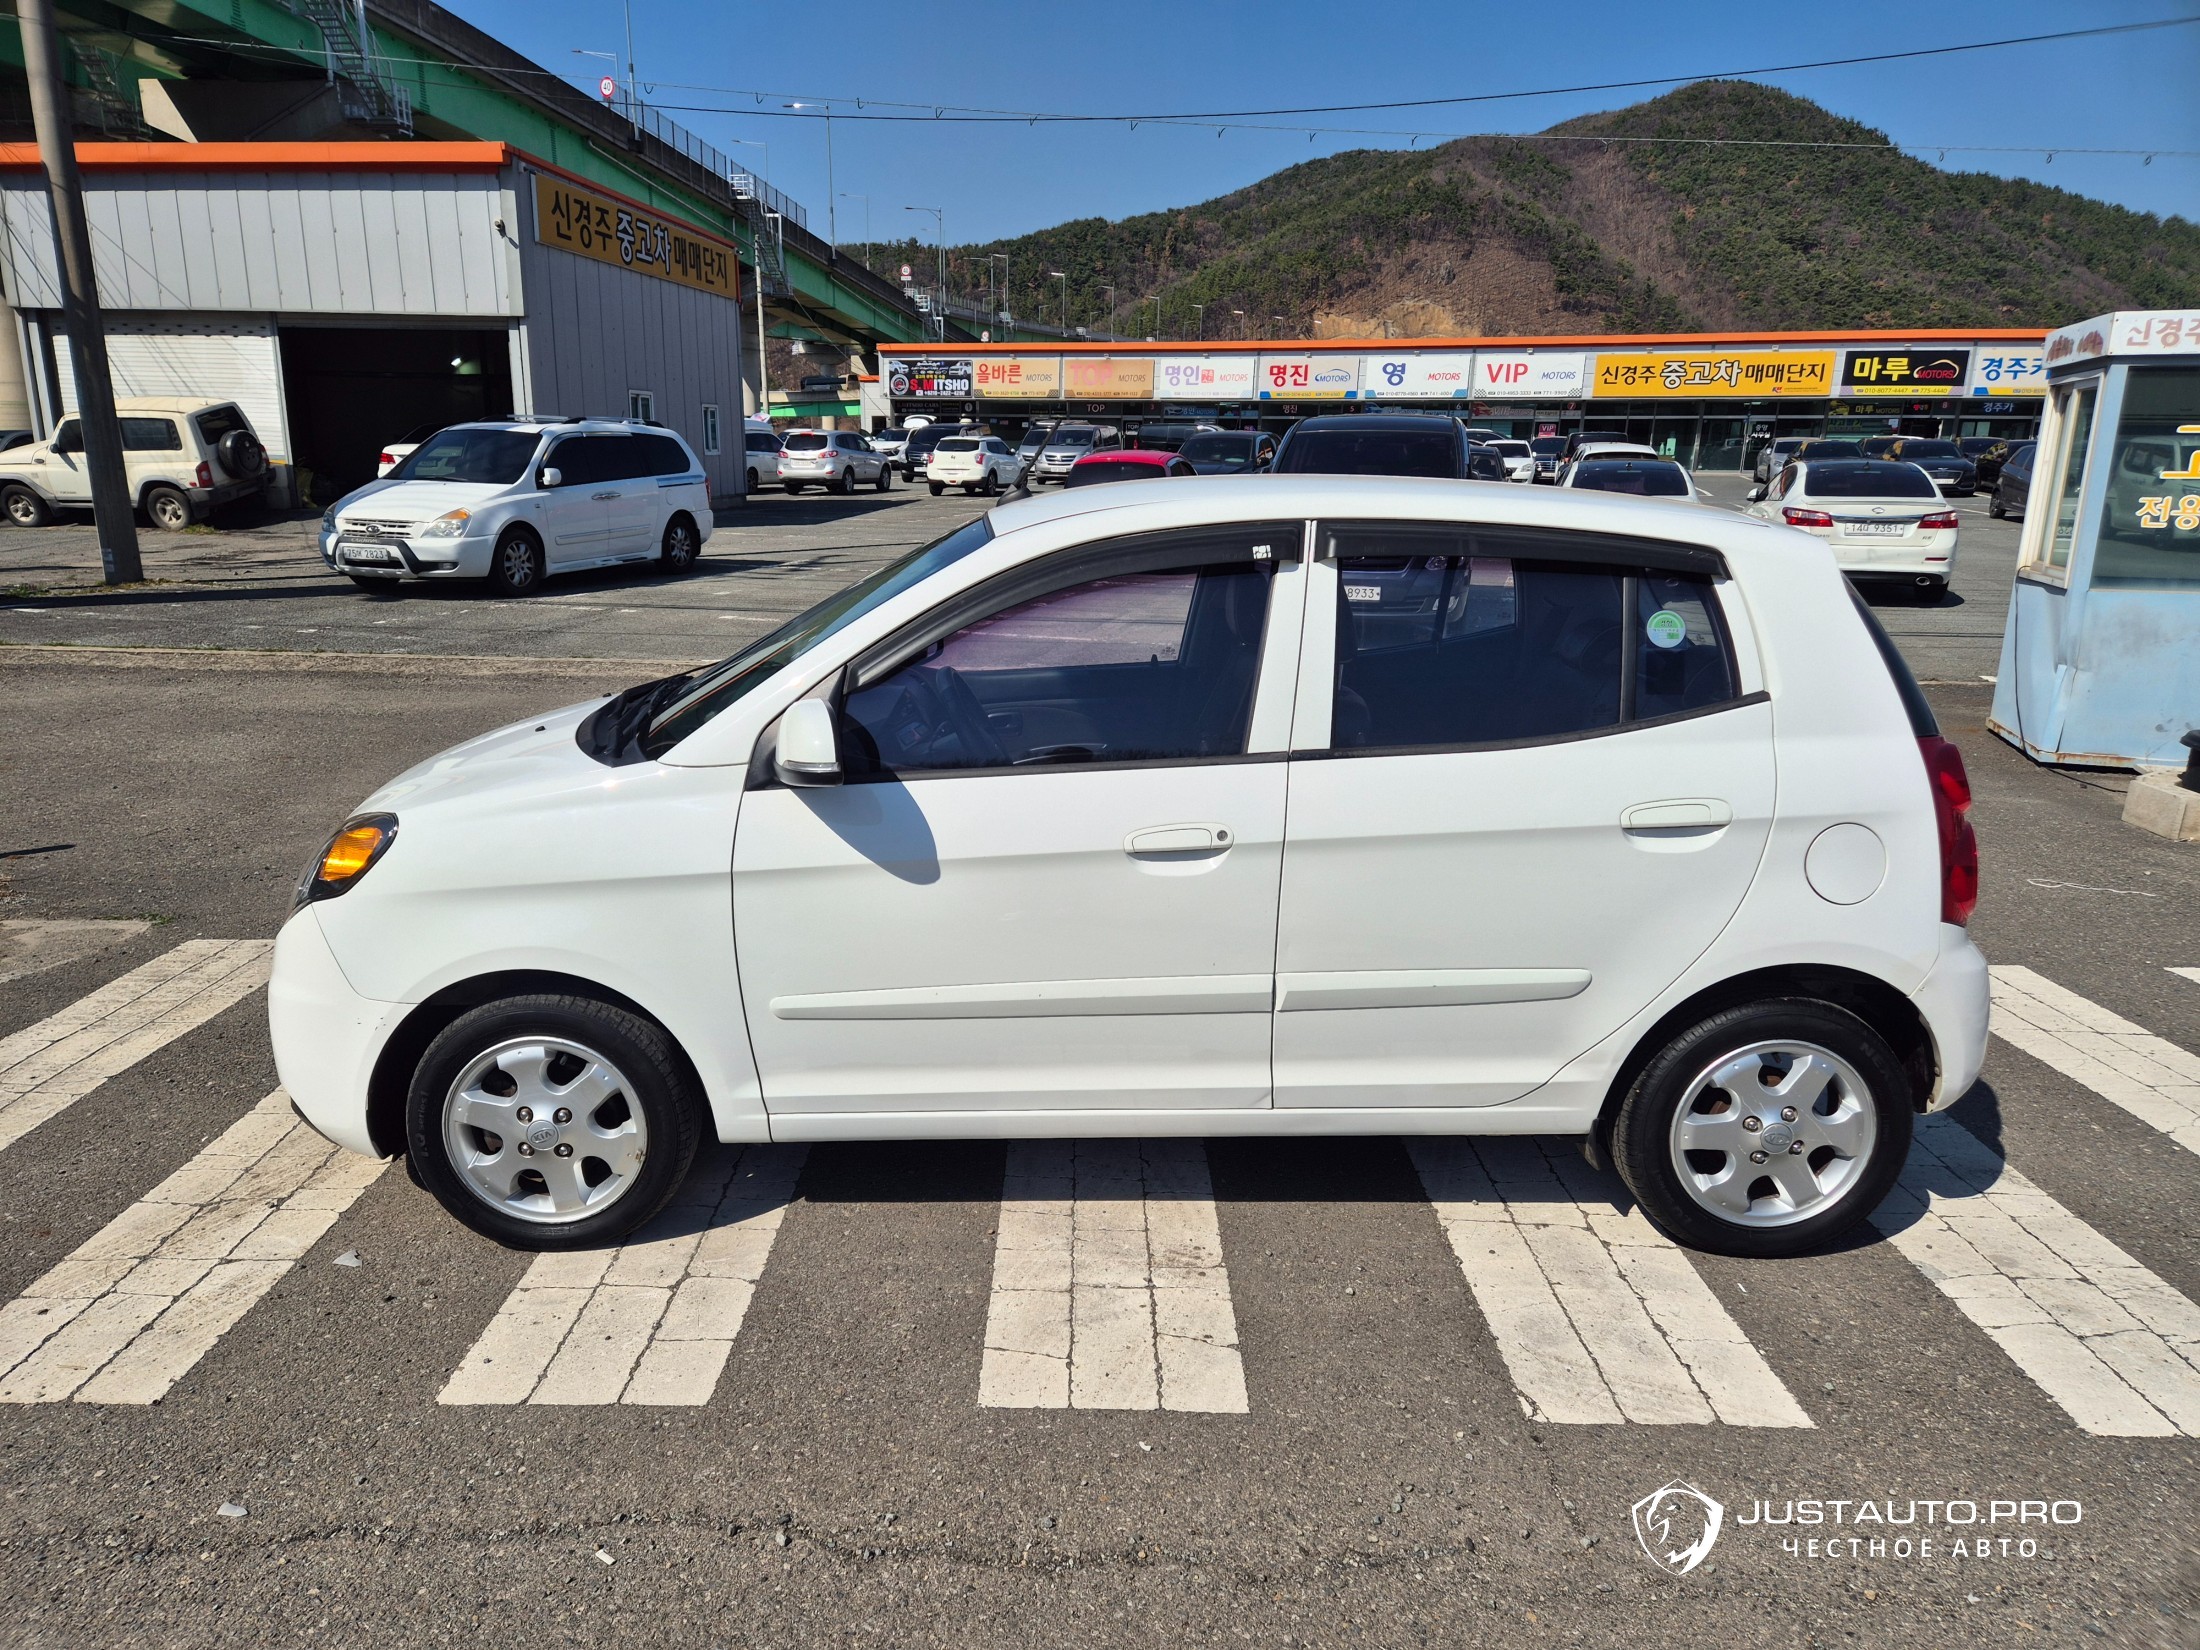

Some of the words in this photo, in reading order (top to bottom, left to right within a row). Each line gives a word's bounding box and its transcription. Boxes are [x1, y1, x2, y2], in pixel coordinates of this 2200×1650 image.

[552, 190, 613, 251] 신경주
[616, 208, 672, 275] 중고차
[673, 236, 728, 288] 매매단지
[976, 363, 1022, 384] 올바른
[1026, 374, 1052, 382] MOTORS
[1070, 363, 1113, 386] TOP
[1118, 374, 1146, 382] MOTORS
[1165, 365, 1200, 386] 명인
[1219, 374, 1248, 382] MOTORS
[1269, 364, 1309, 387] 명진
[1319, 374, 1349, 382] MOTORS
[1382, 362, 1406, 386] 영
[1428, 372, 1461, 380] MOTORS
[1487, 363, 1529, 383] VIP
[1541, 372, 1576, 380] MOTORS
[1601, 365, 1657, 385] 신경주
[1660, 359, 1742, 389] 중고차
[1744, 363, 1826, 384] 매매단지
[1853, 357, 1910, 382] 마루
[1918, 370, 1954, 379] MOTORS
[1086, 404, 1106, 412] TOP
[1282, 404, 1298, 414] 명진
[1855, 405, 1874, 414] 마루
[1984, 402, 2014, 412] 경주카
[1874, 524, 1898, 533] 9351
[364, 550, 384, 558] 2823
[1347, 588, 1374, 598] 8933
[534, 1130, 553, 1142] KIA
